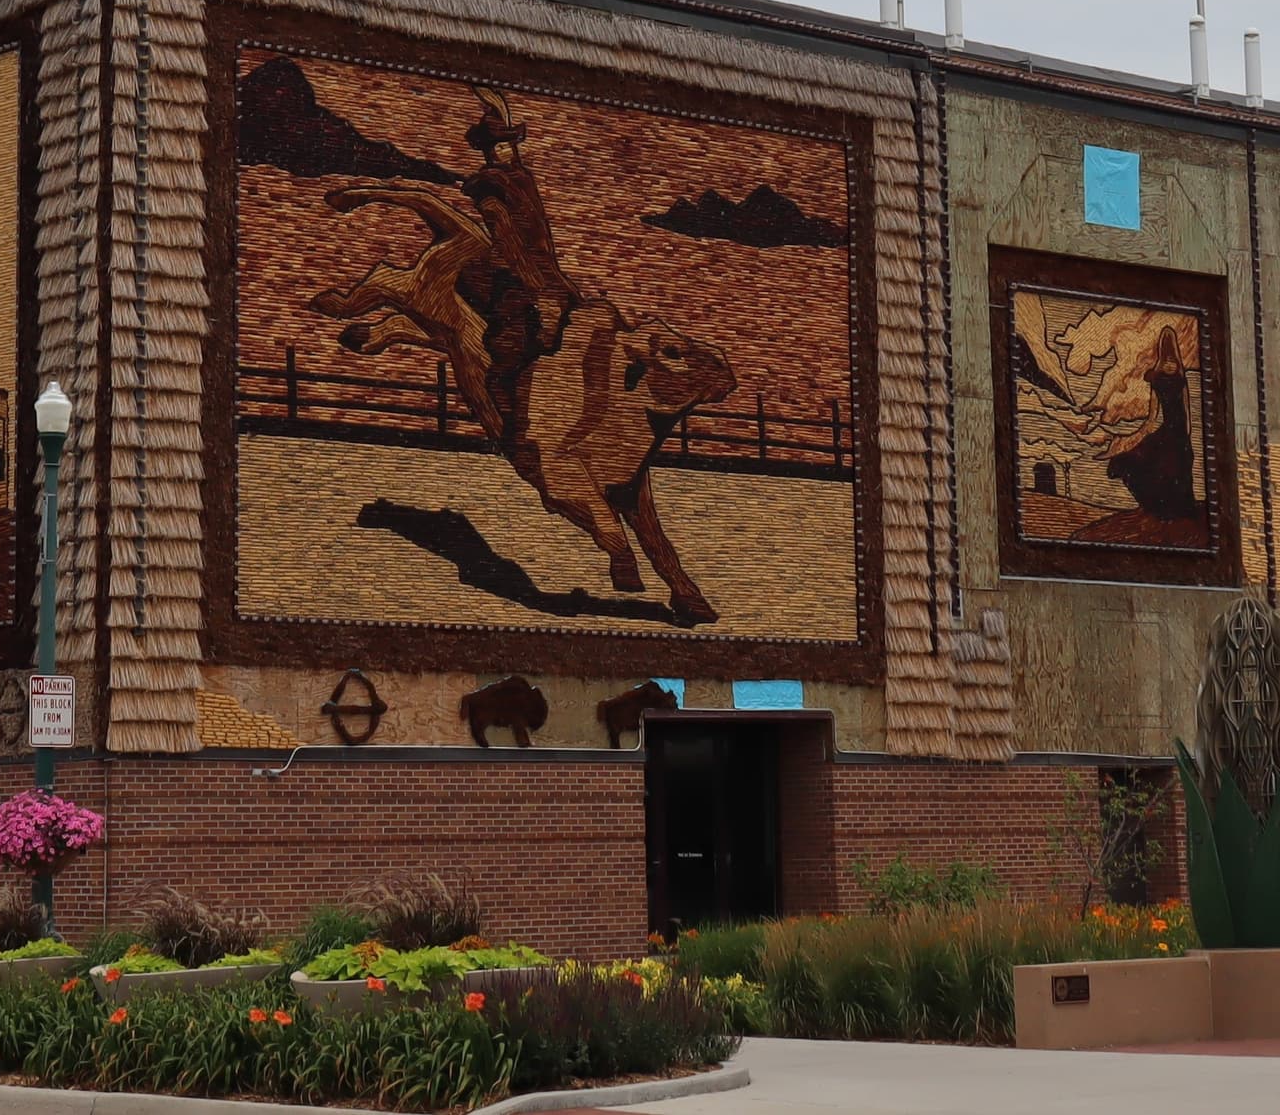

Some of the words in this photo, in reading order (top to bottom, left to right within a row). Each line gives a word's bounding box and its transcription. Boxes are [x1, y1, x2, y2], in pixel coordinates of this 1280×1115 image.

[32, 680, 43, 693] NO
[45, 681, 72, 692] PARKING
[33, 699, 48, 709] THIS
[51, 699, 72, 709] BLOCK
[43, 713, 61, 723] FROM
